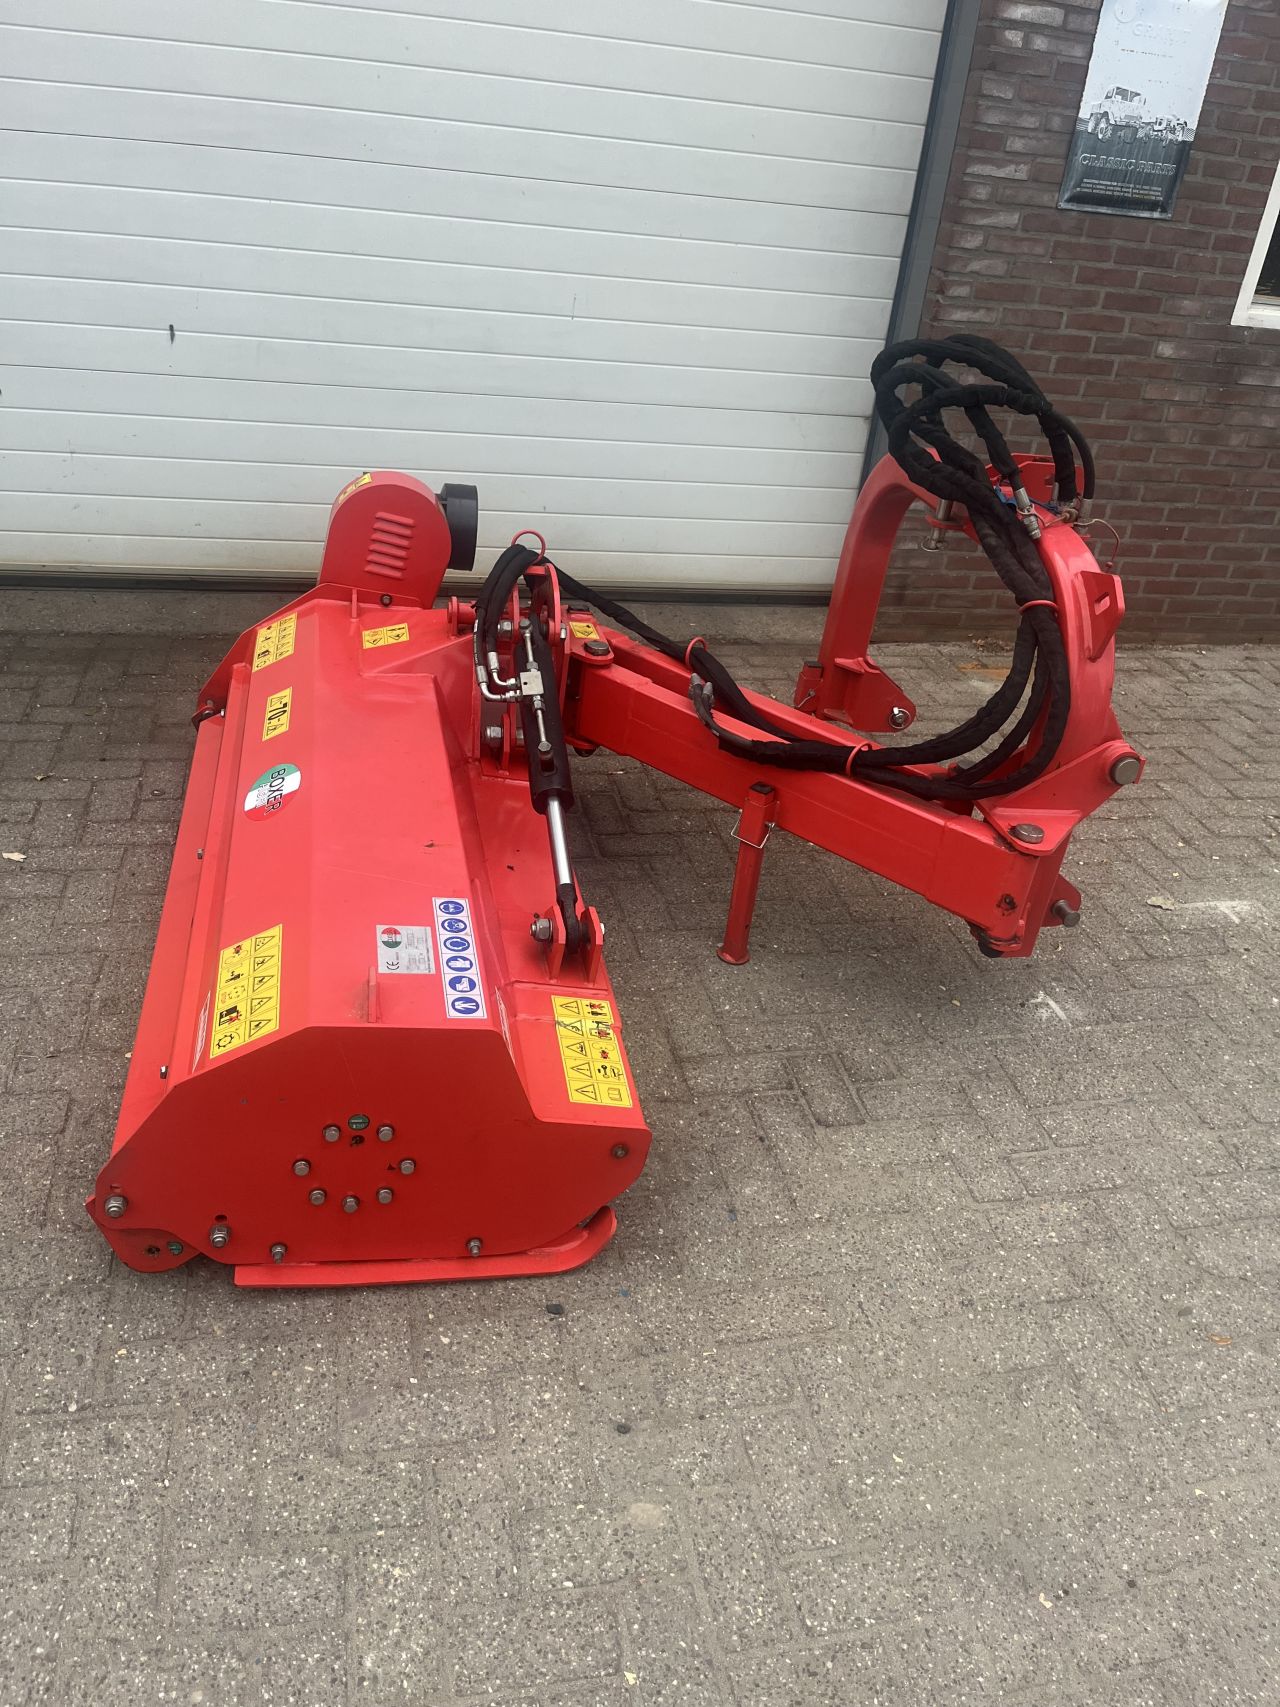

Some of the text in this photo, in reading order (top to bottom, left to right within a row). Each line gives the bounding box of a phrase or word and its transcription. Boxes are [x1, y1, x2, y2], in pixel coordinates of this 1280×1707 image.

[1079, 153, 1177, 176] CLASSIC PARTS
[264, 768, 287, 815] BOXER
